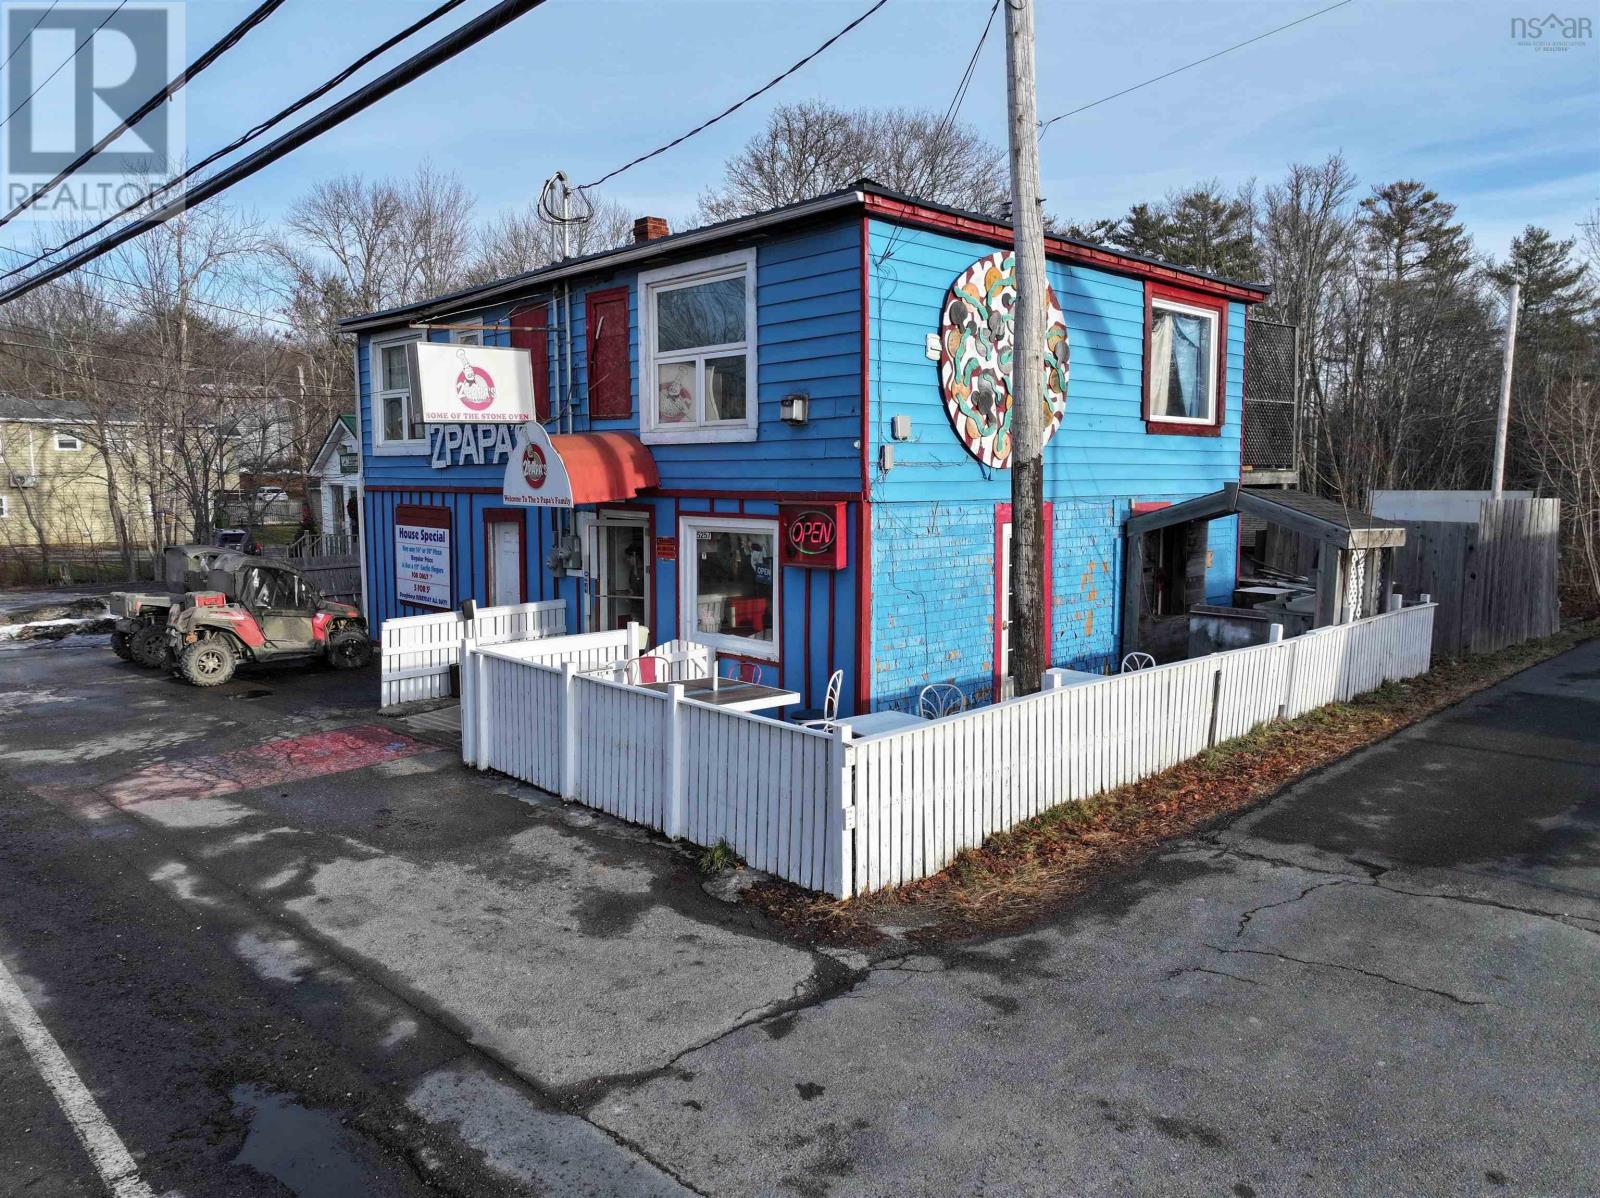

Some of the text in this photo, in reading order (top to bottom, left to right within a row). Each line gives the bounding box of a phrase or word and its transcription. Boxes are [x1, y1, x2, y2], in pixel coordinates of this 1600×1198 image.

[451, 412, 461, 420] OF
[399, 528, 446, 543] House Special
[792, 522, 832, 543] OPEN
